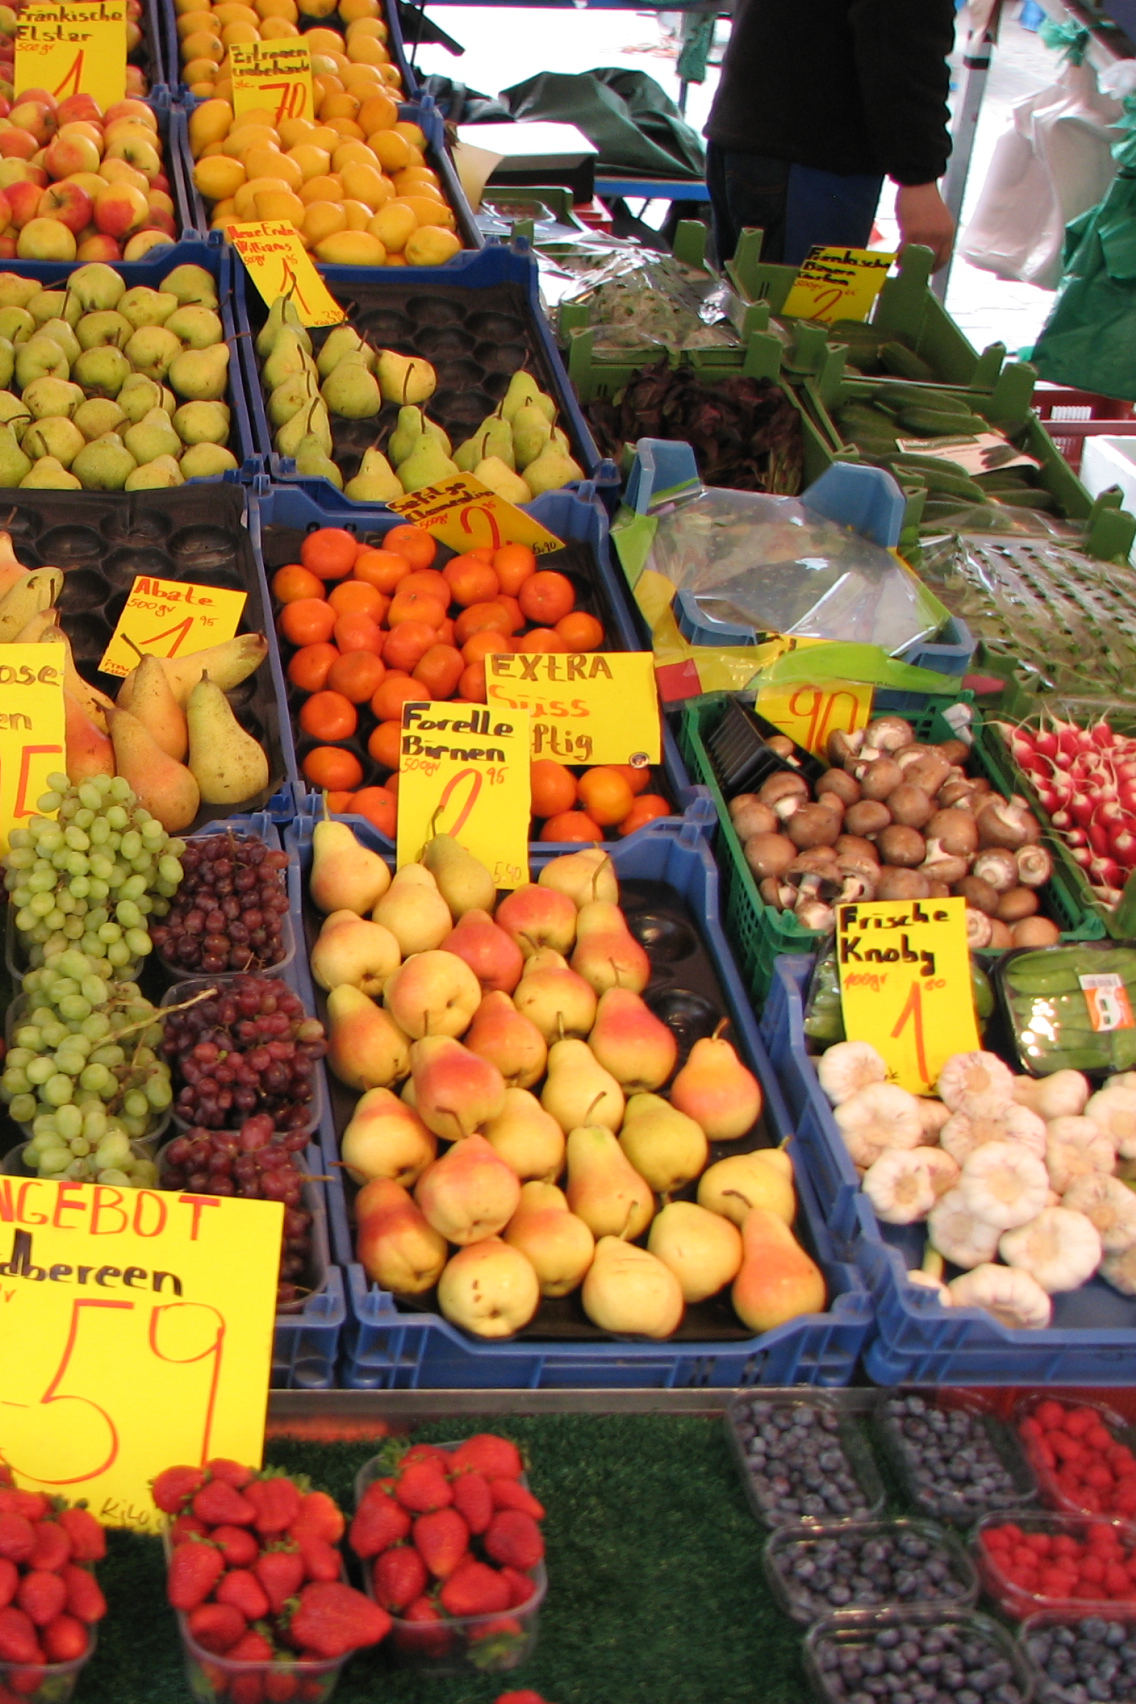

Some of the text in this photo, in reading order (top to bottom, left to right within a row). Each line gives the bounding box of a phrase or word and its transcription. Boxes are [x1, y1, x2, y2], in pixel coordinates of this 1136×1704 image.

[16, 25, 93, 42] Elstar
[133, 577, 216, 608] Abate
[199, 615, 219, 627] 95
[401, 702, 515, 738] Forelle
[401, 734, 506, 763] Birnen
[531, 722, 594, 762] ftig
[839, 902, 951, 933] Frische
[890, 980, 930, 1084] 1
